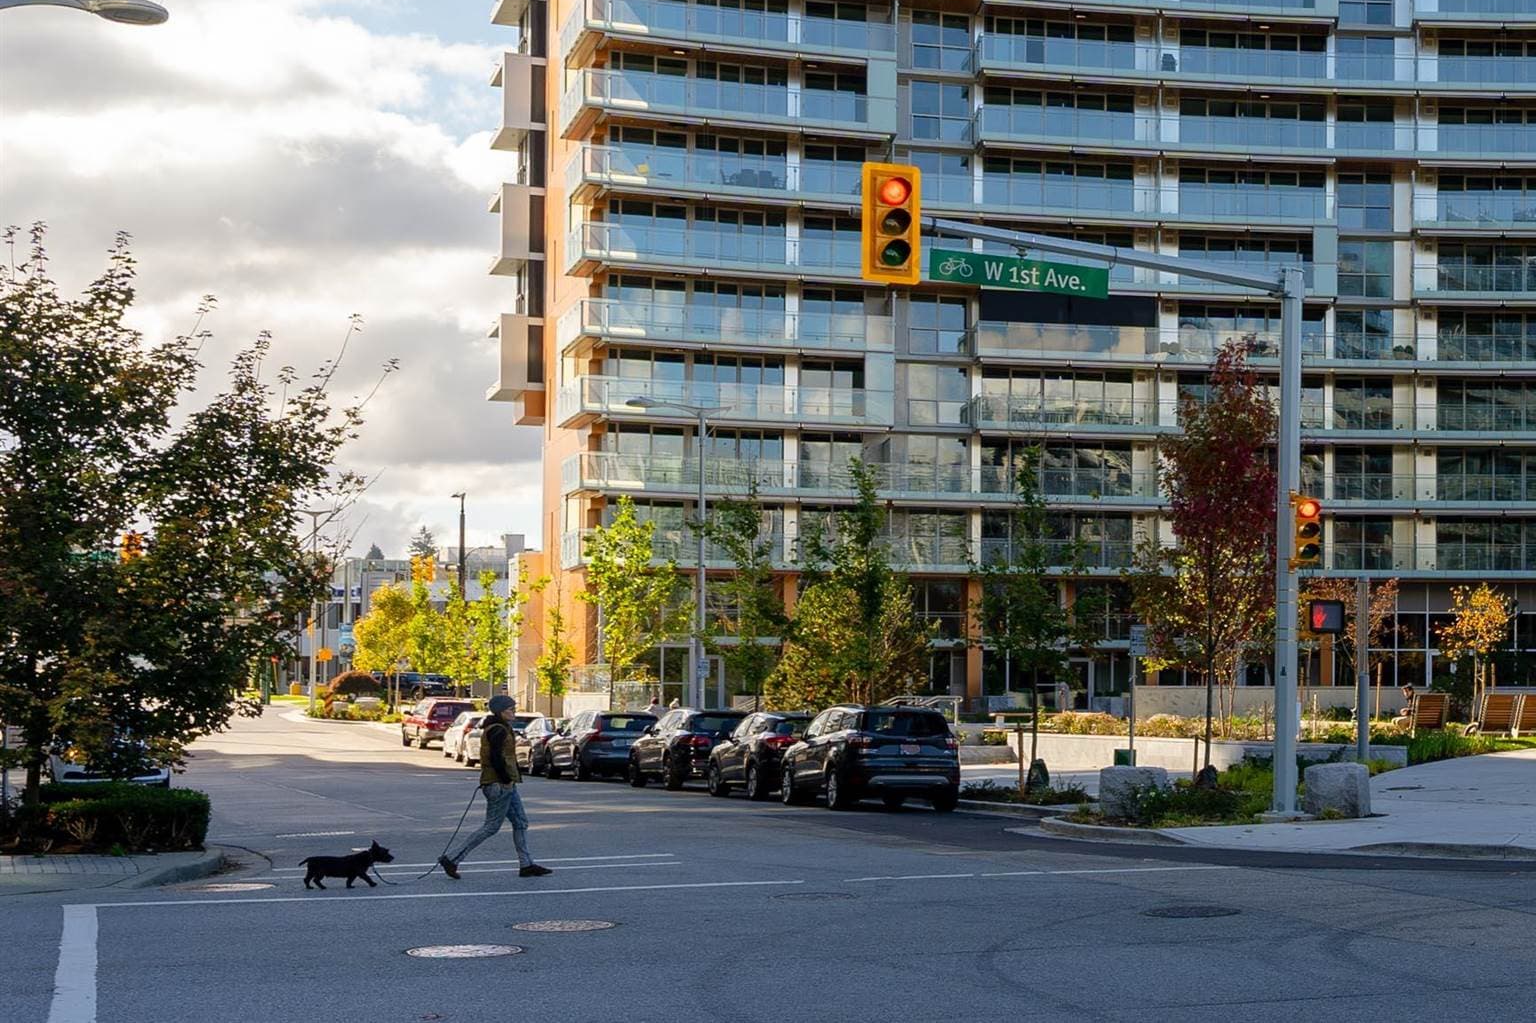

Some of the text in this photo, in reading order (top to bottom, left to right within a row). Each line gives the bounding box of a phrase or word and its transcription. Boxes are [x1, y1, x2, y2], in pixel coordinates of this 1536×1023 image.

[984, 261, 1086, 291] W 1st Ave.
